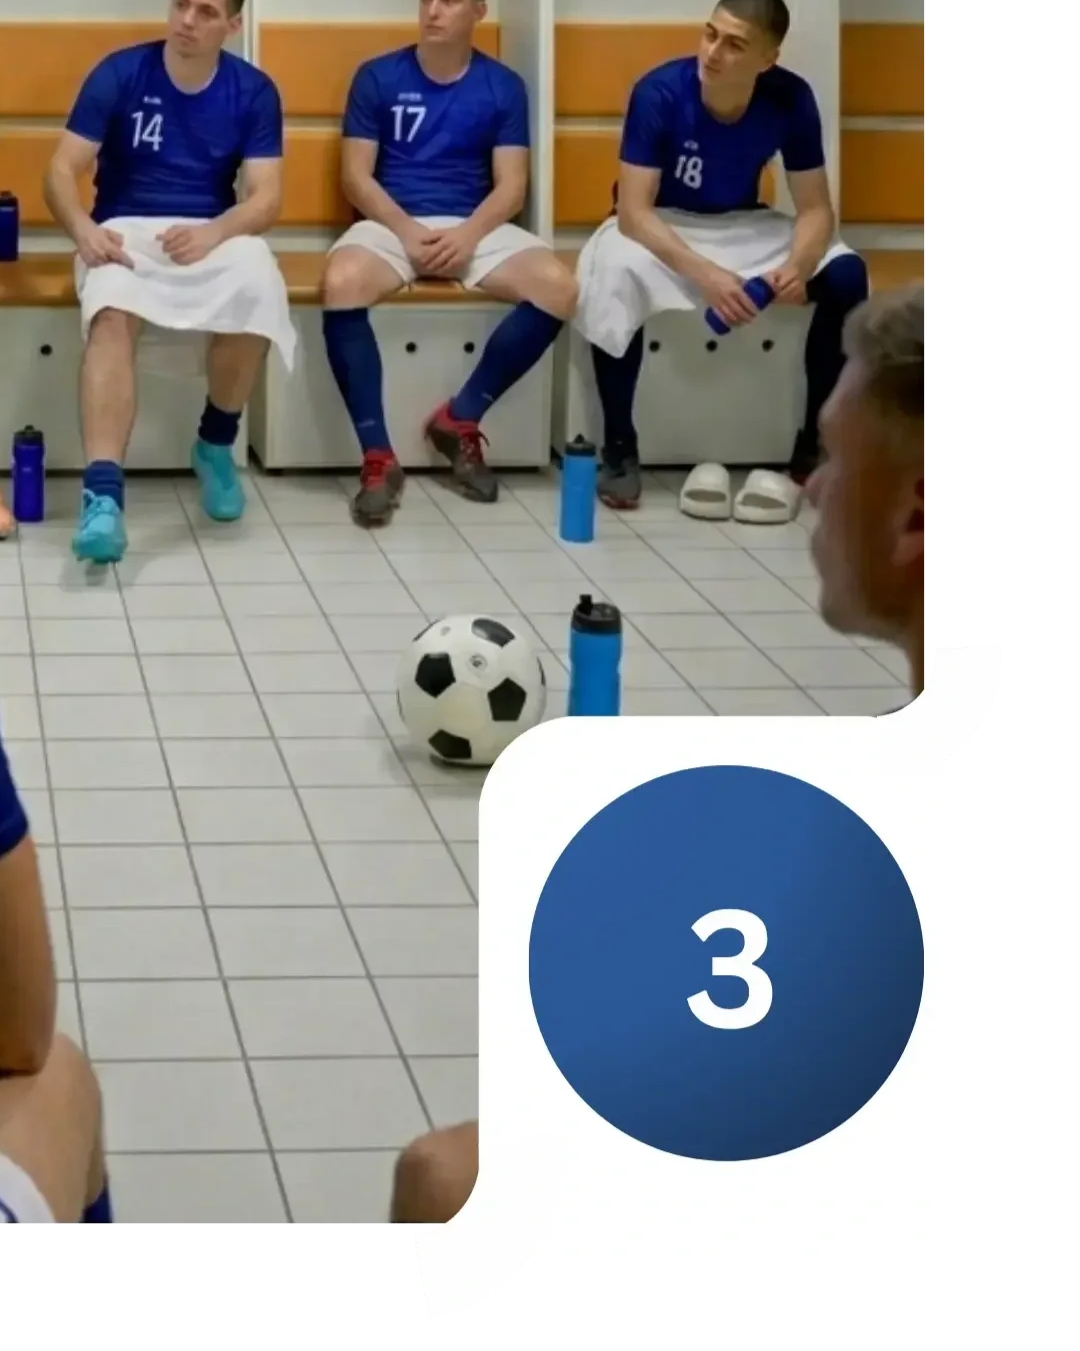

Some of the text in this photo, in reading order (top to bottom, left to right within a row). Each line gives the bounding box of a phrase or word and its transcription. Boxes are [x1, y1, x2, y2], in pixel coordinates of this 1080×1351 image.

[131, 110, 164, 152] 14
[390, 105, 428, 143] 17
[674, 155, 704, 189] 18
